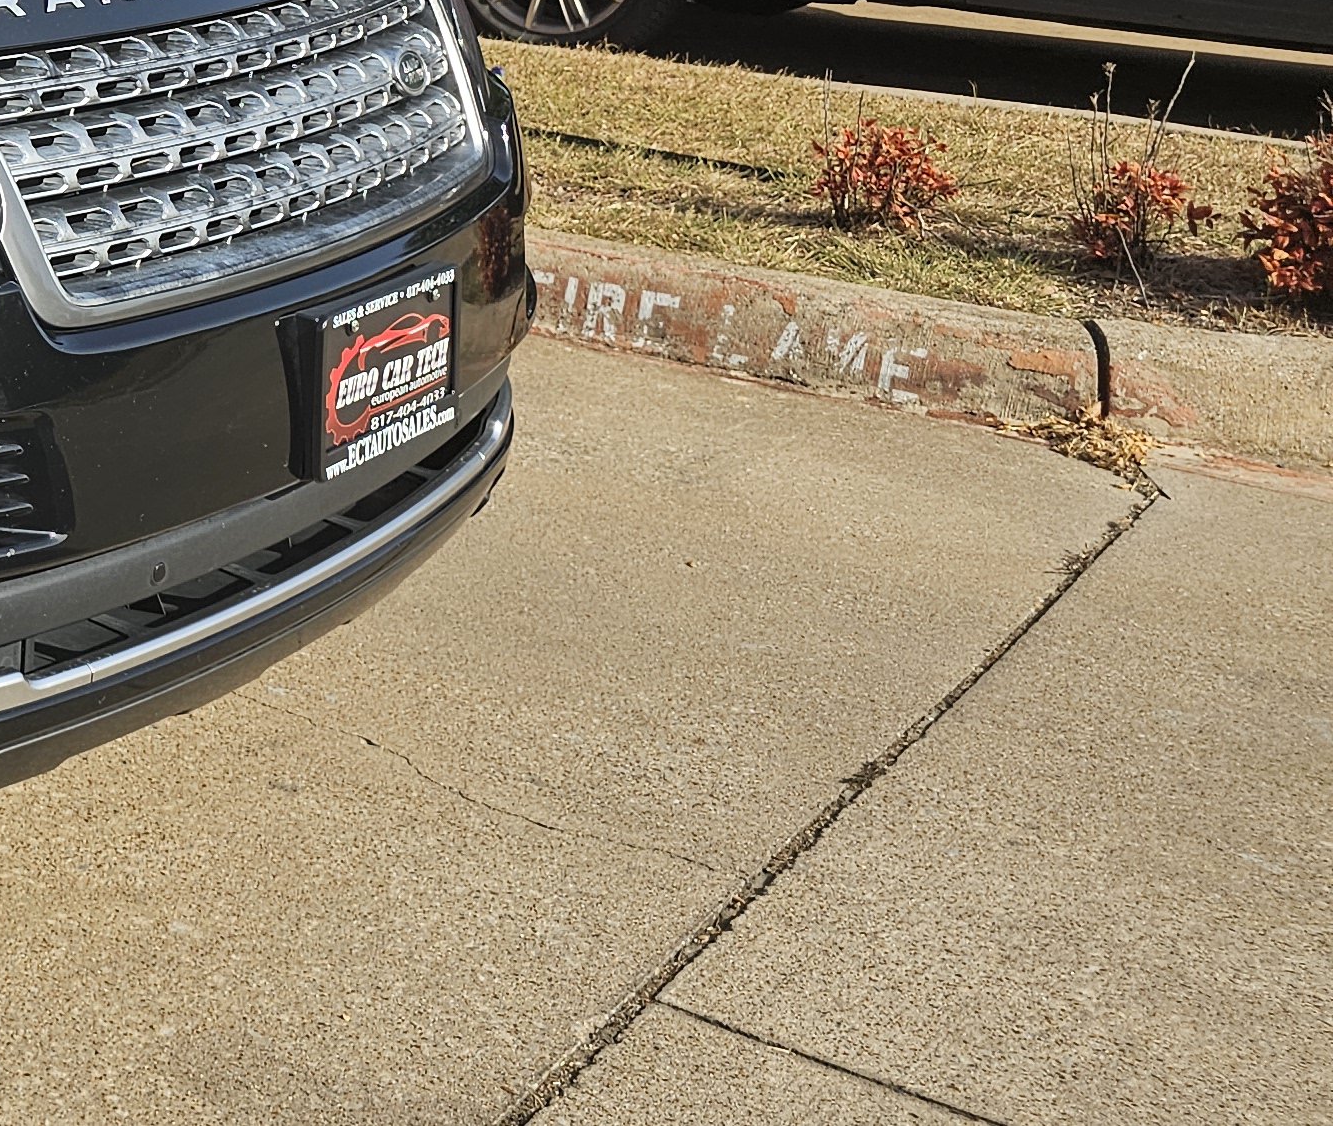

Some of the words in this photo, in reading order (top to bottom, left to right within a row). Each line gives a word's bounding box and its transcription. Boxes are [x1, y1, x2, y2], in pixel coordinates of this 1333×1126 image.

[332, 307, 356, 328] SALES
[356, 305, 365, 319] &
[365, 291, 399, 315] SERVICE
[336, 367, 379, 410] EURO
[382, 354, 414, 391] CAR
[416, 337, 450, 378] TECH
[371, 385, 409, 407] european
[409, 366, 448, 393] automotive
[371, 387, 445, 430] 817-404-4033
[326, 404, 454, 480] www.ECTAUTOSALES.com
